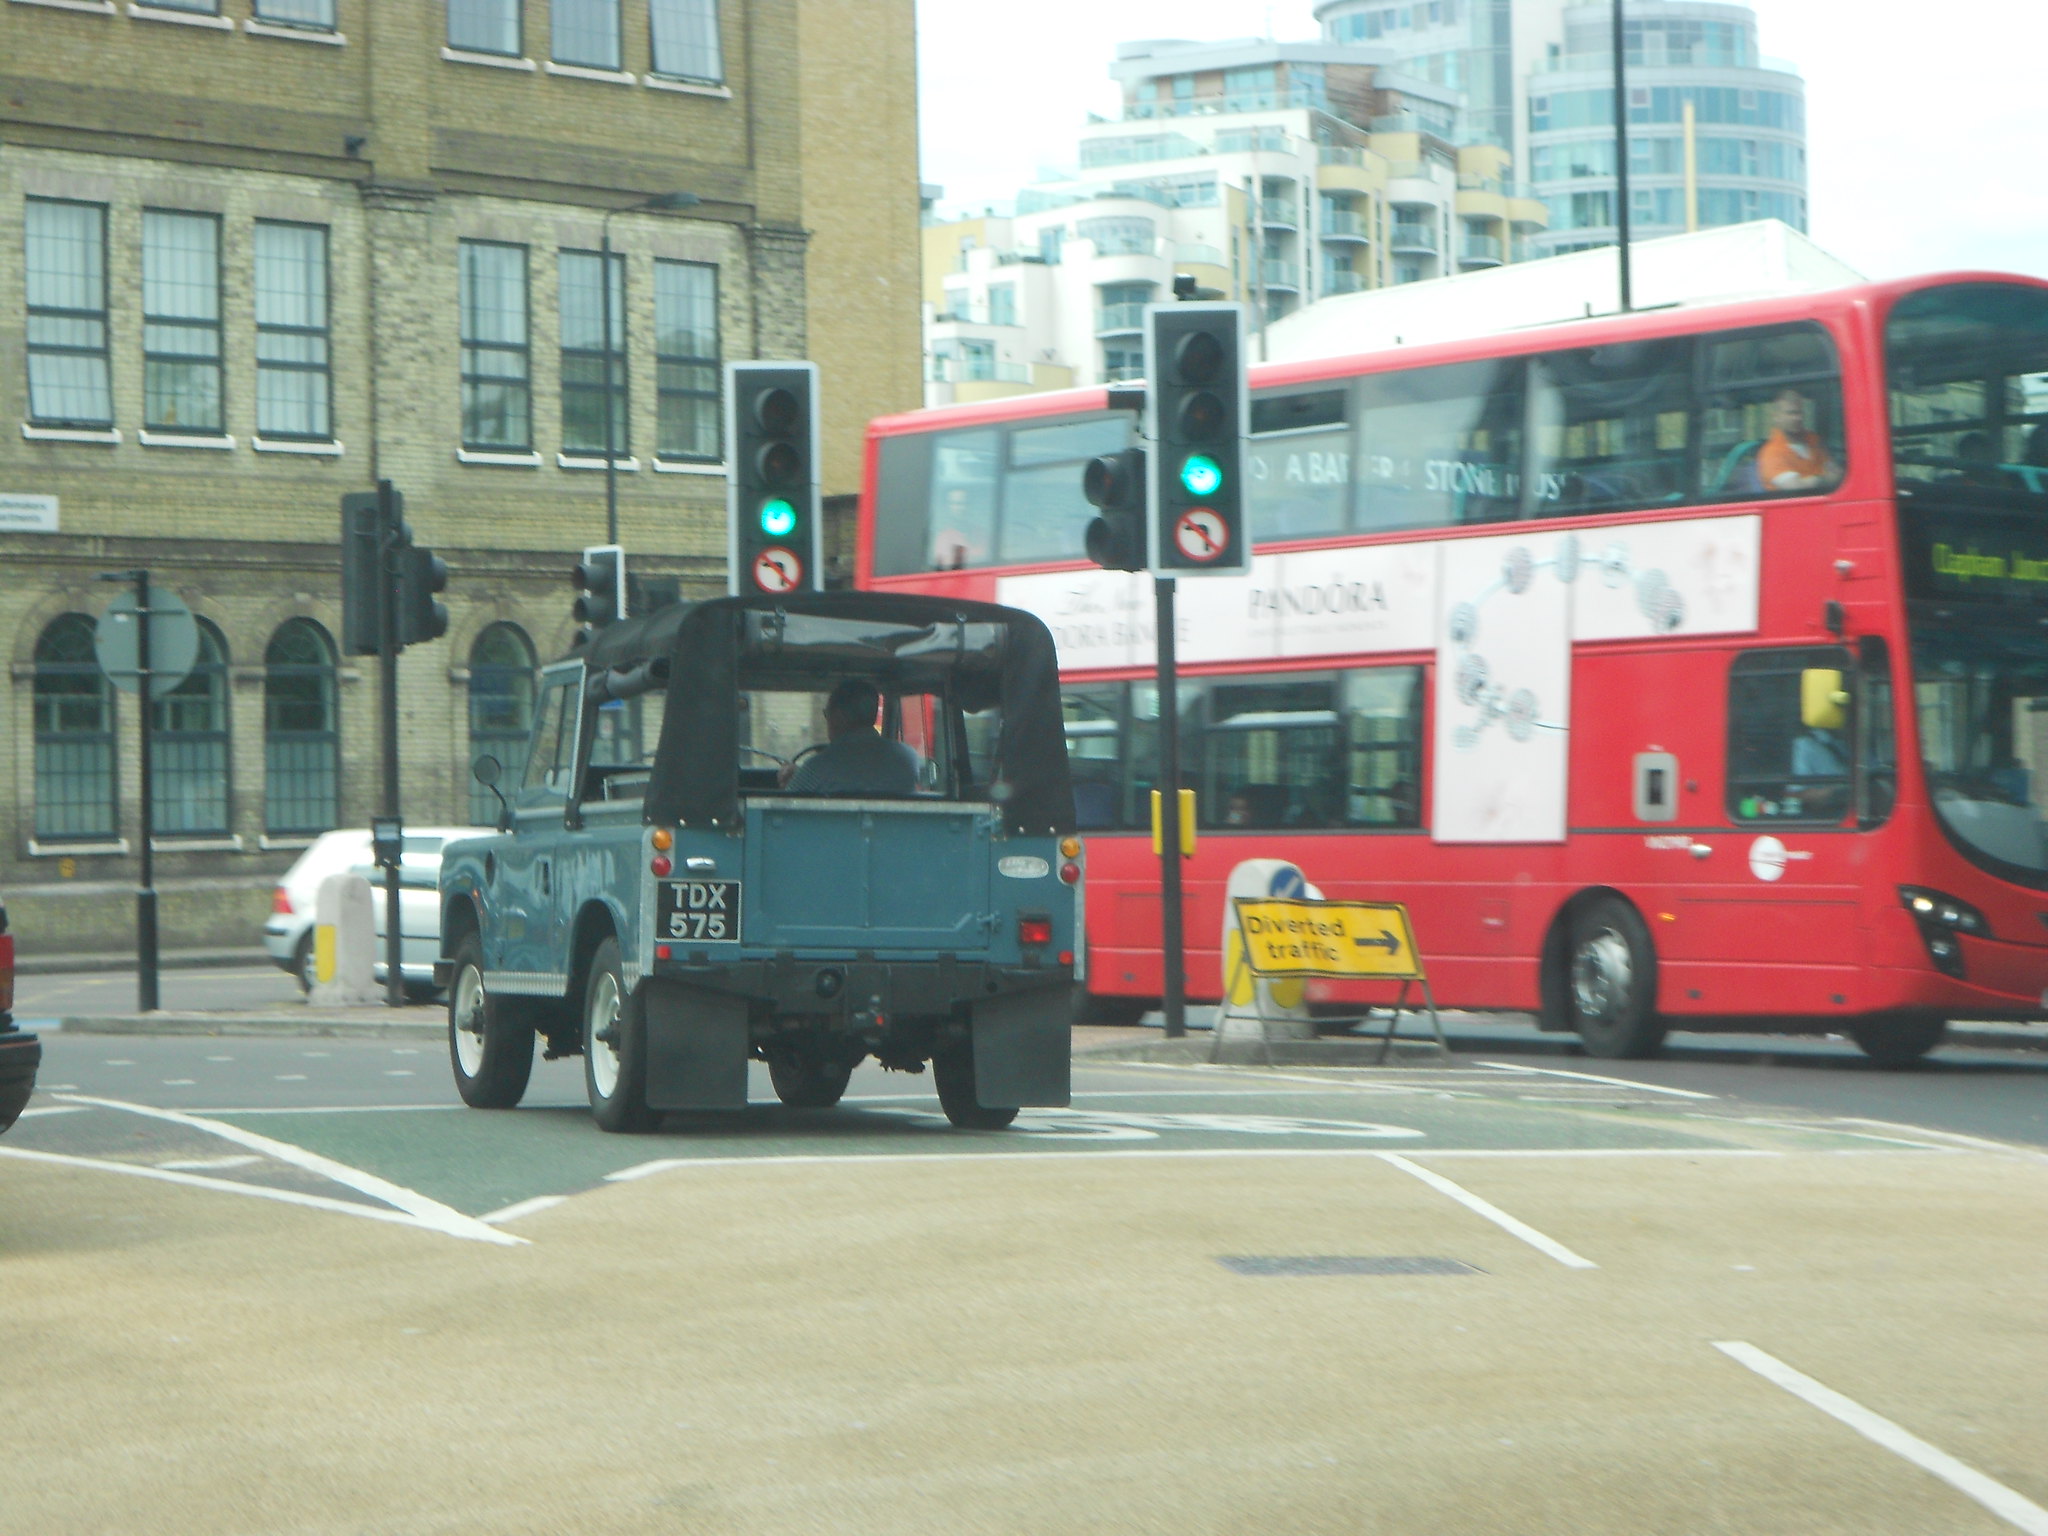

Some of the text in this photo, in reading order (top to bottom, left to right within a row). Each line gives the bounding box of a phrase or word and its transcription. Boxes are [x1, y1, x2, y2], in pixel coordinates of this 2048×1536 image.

[1248, 577, 1389, 619] PANDORA
[670, 883, 727, 909] TDX
[669, 912, 726, 938] 575
[1246, 915, 1346, 938] Diverted
[1266, 940, 1339, 962] traffic
